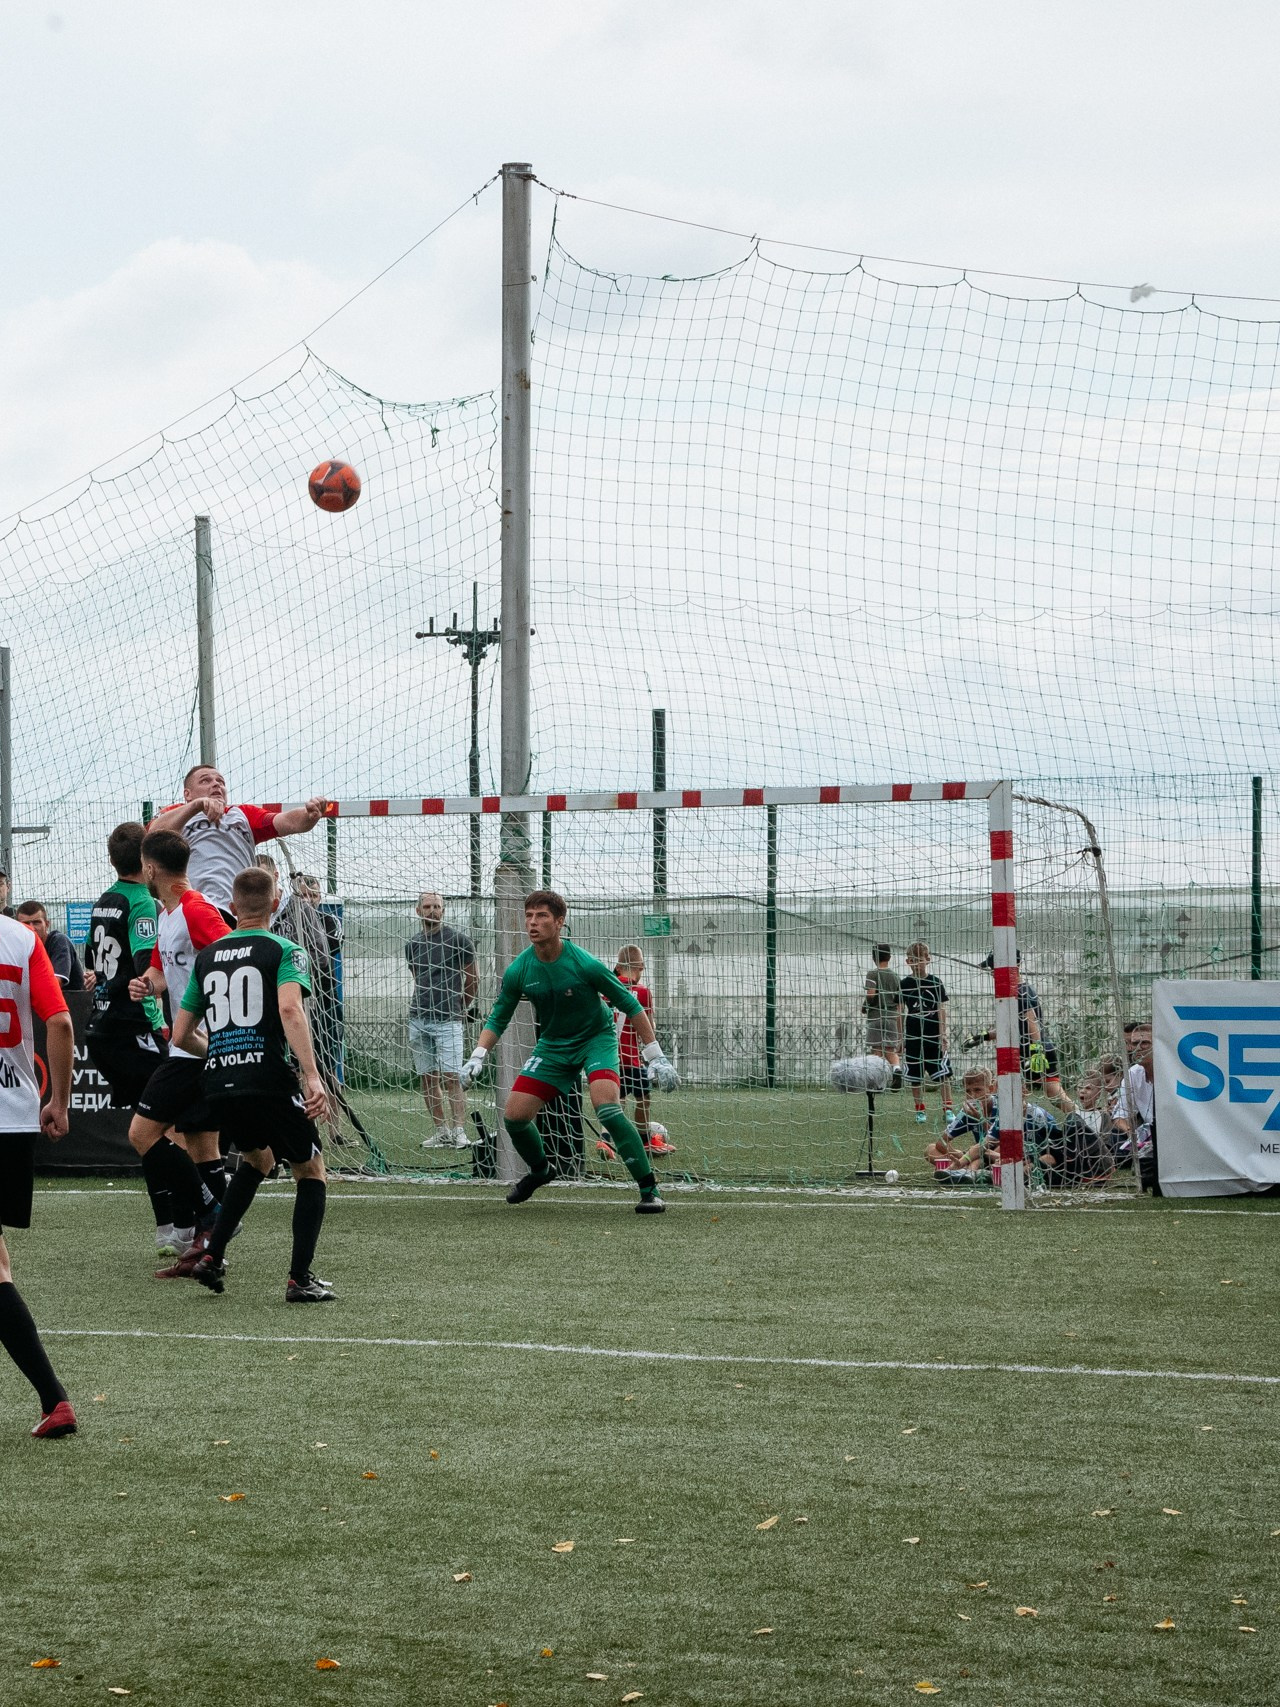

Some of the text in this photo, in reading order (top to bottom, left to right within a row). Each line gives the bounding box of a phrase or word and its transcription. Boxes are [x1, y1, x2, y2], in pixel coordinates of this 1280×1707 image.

[92, 925, 122, 981] 23
[203, 966, 264, 1033] 30
[219, 1051, 265, 1068] VOLAT
